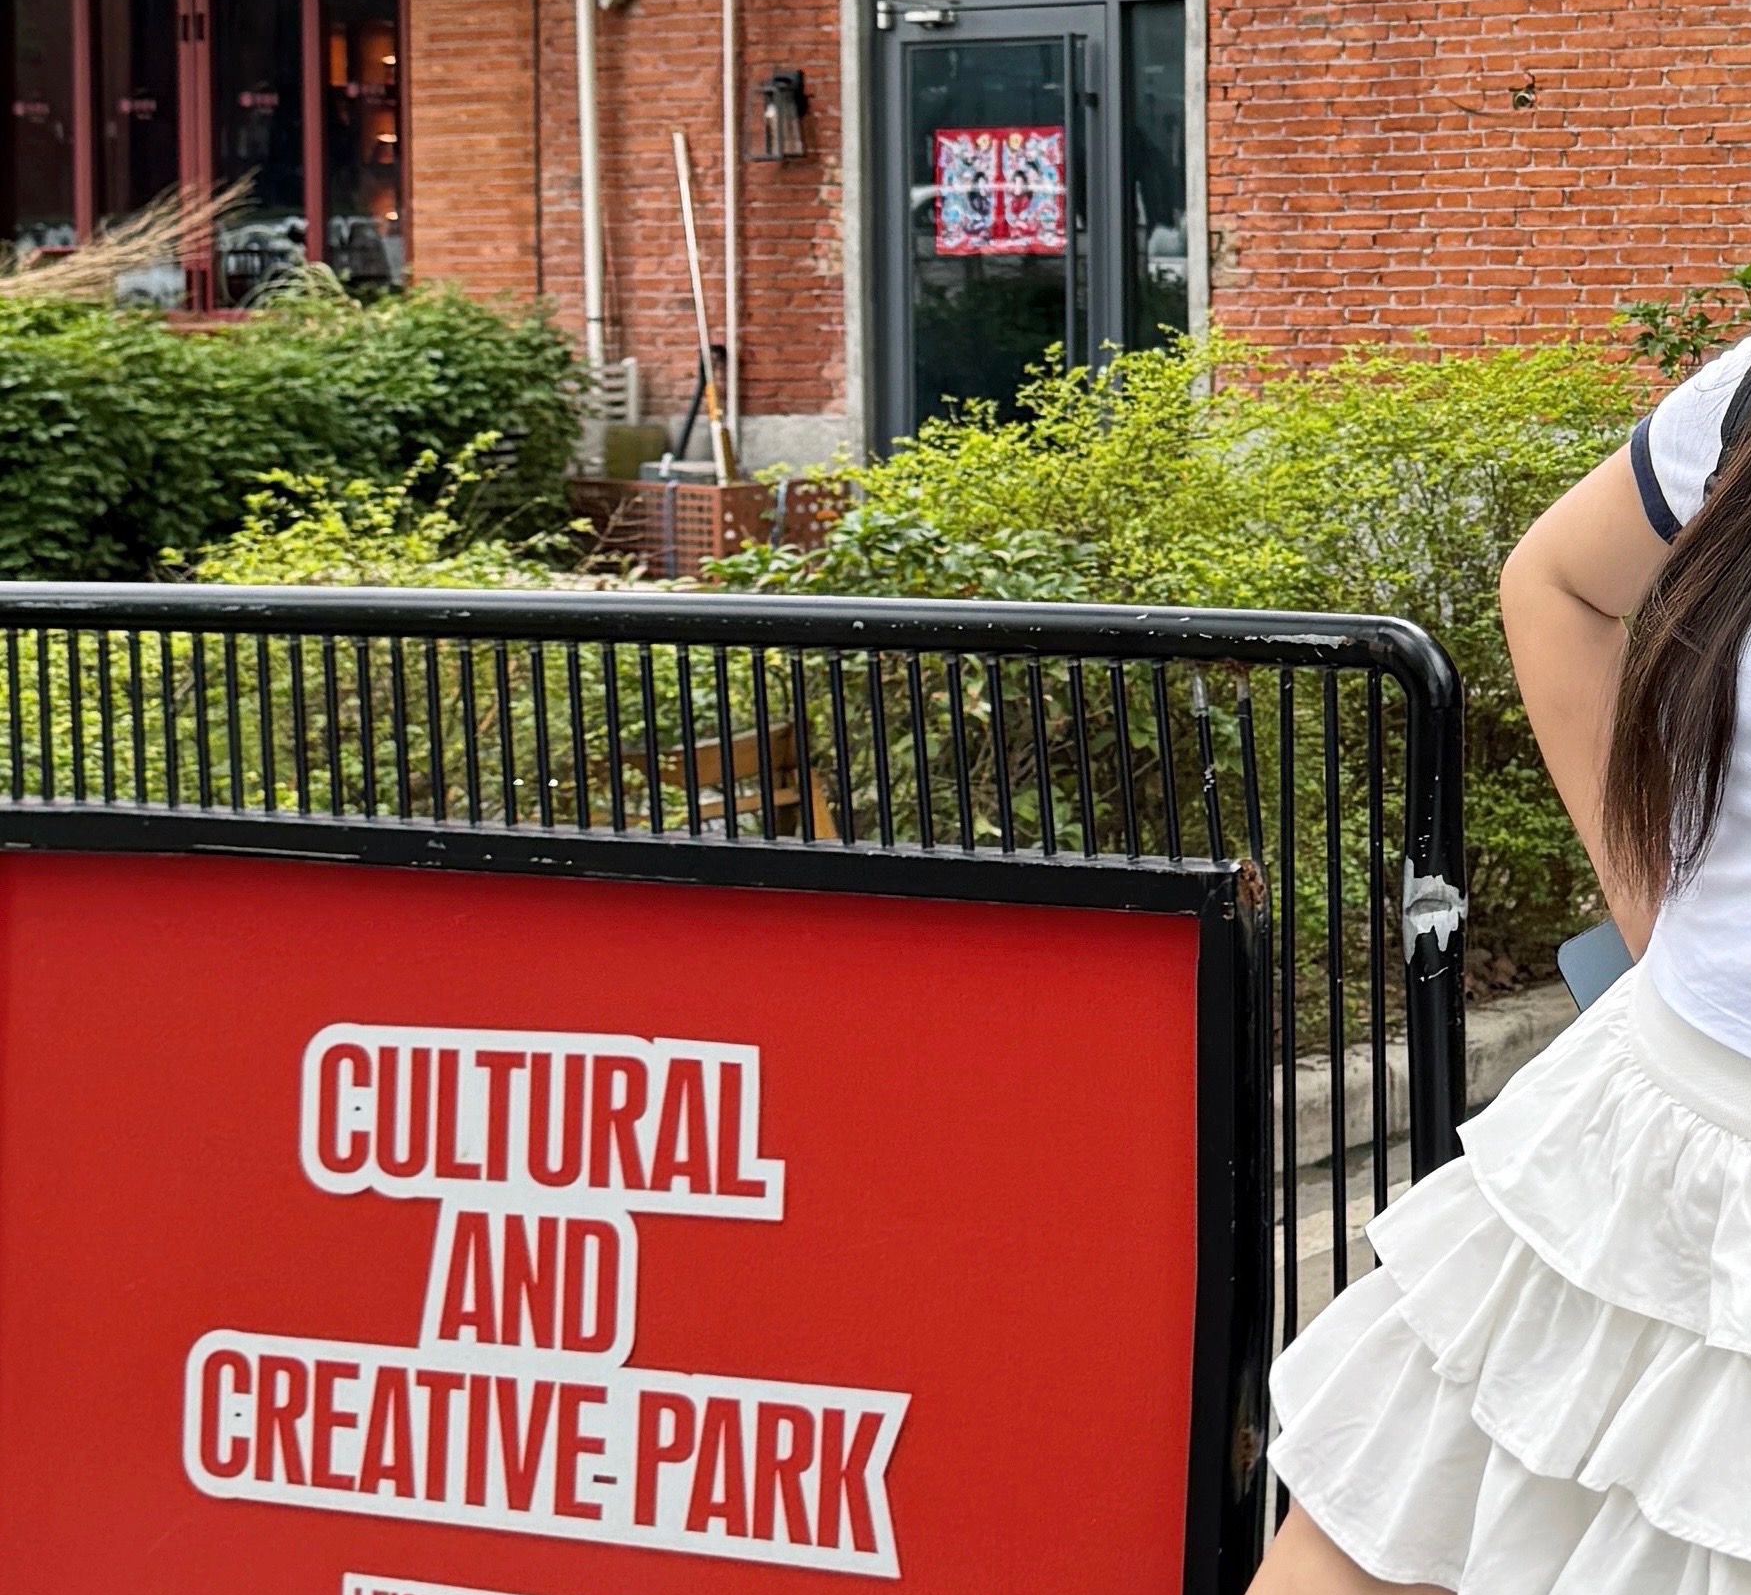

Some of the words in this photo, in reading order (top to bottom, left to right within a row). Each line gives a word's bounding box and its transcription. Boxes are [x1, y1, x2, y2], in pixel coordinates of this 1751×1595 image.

[317, 1043, 766, 1200] CULTURAL
[438, 1211, 620, 1354] AND
[199, 1349, 608, 1522] CREATIVE
[633, 1390, 885, 1555] PARK
